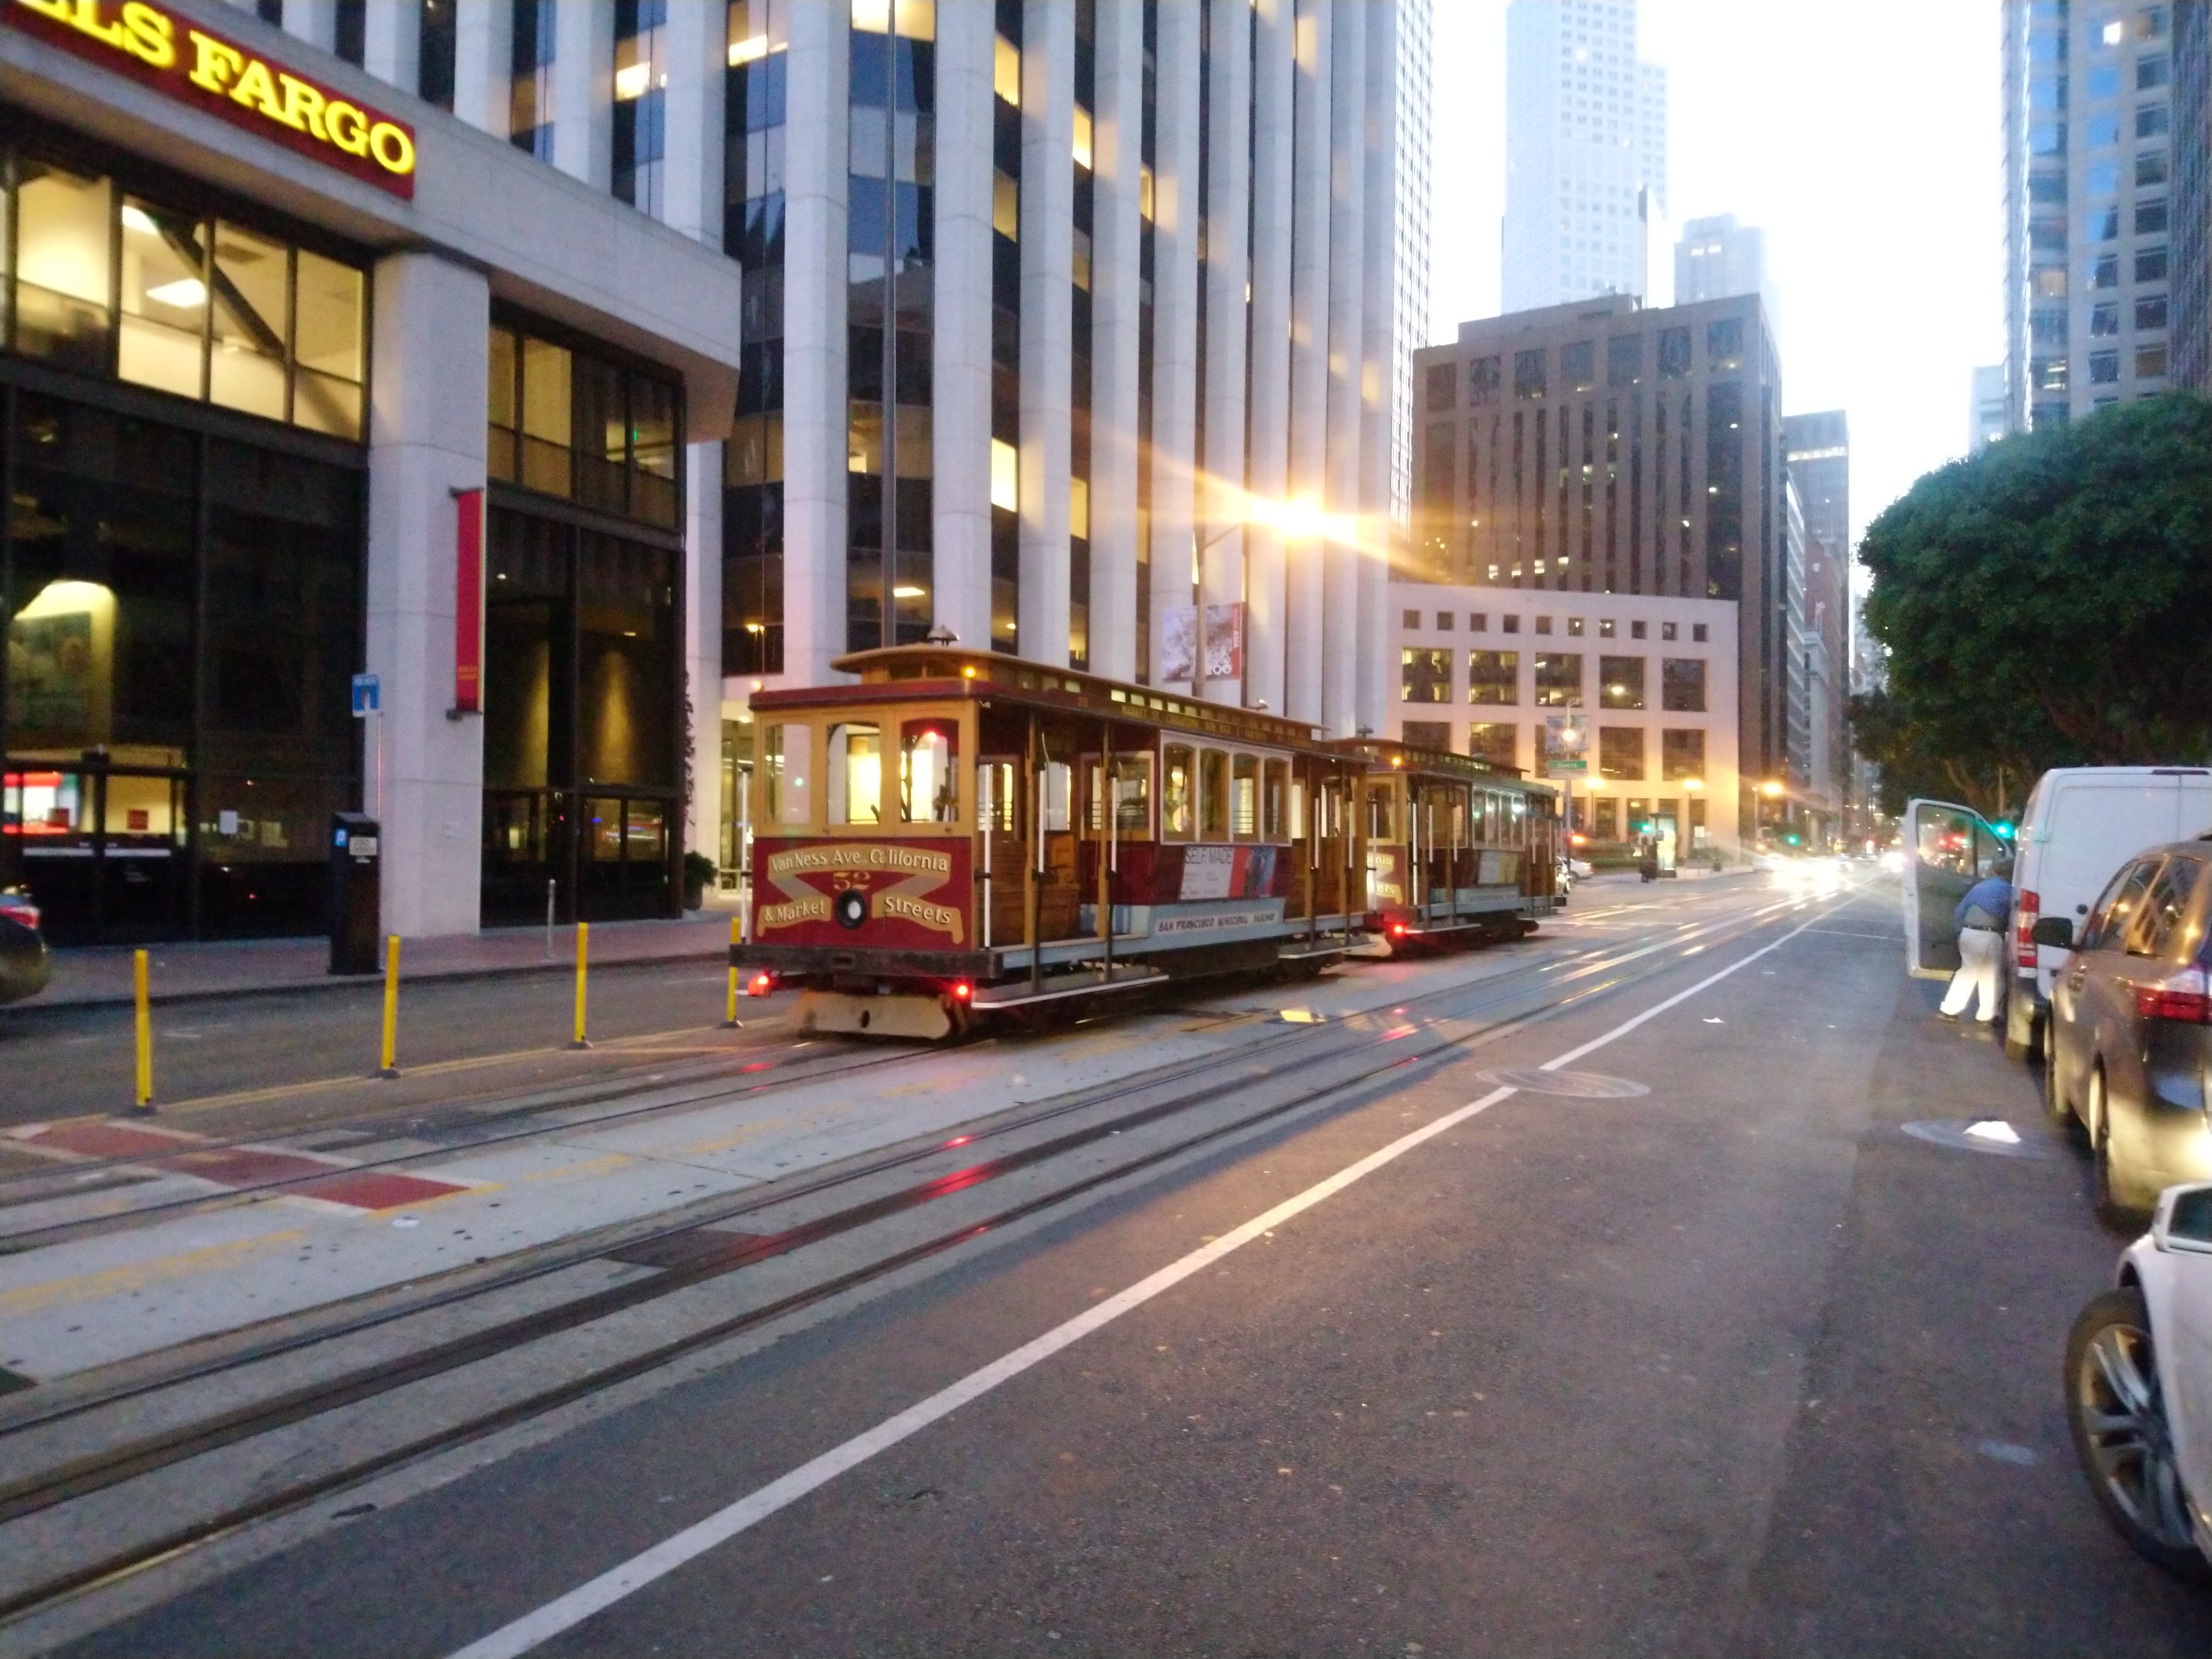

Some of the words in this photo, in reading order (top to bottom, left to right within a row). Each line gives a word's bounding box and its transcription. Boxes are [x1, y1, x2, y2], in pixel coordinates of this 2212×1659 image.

[189, 29, 416, 174] FARGO
[771, 856, 794, 873] Van
[795, 850, 827, 867] Ness
[869, 848, 949, 873] California
[833, 871, 871, 892] 52
[764, 906, 773, 922] &
[777, 899, 825, 922] Market
[884, 896, 952, 925] Streets
[1158, 921, 1174, 932] SAN
[1176, 917, 1215, 930] FRANCISCO
